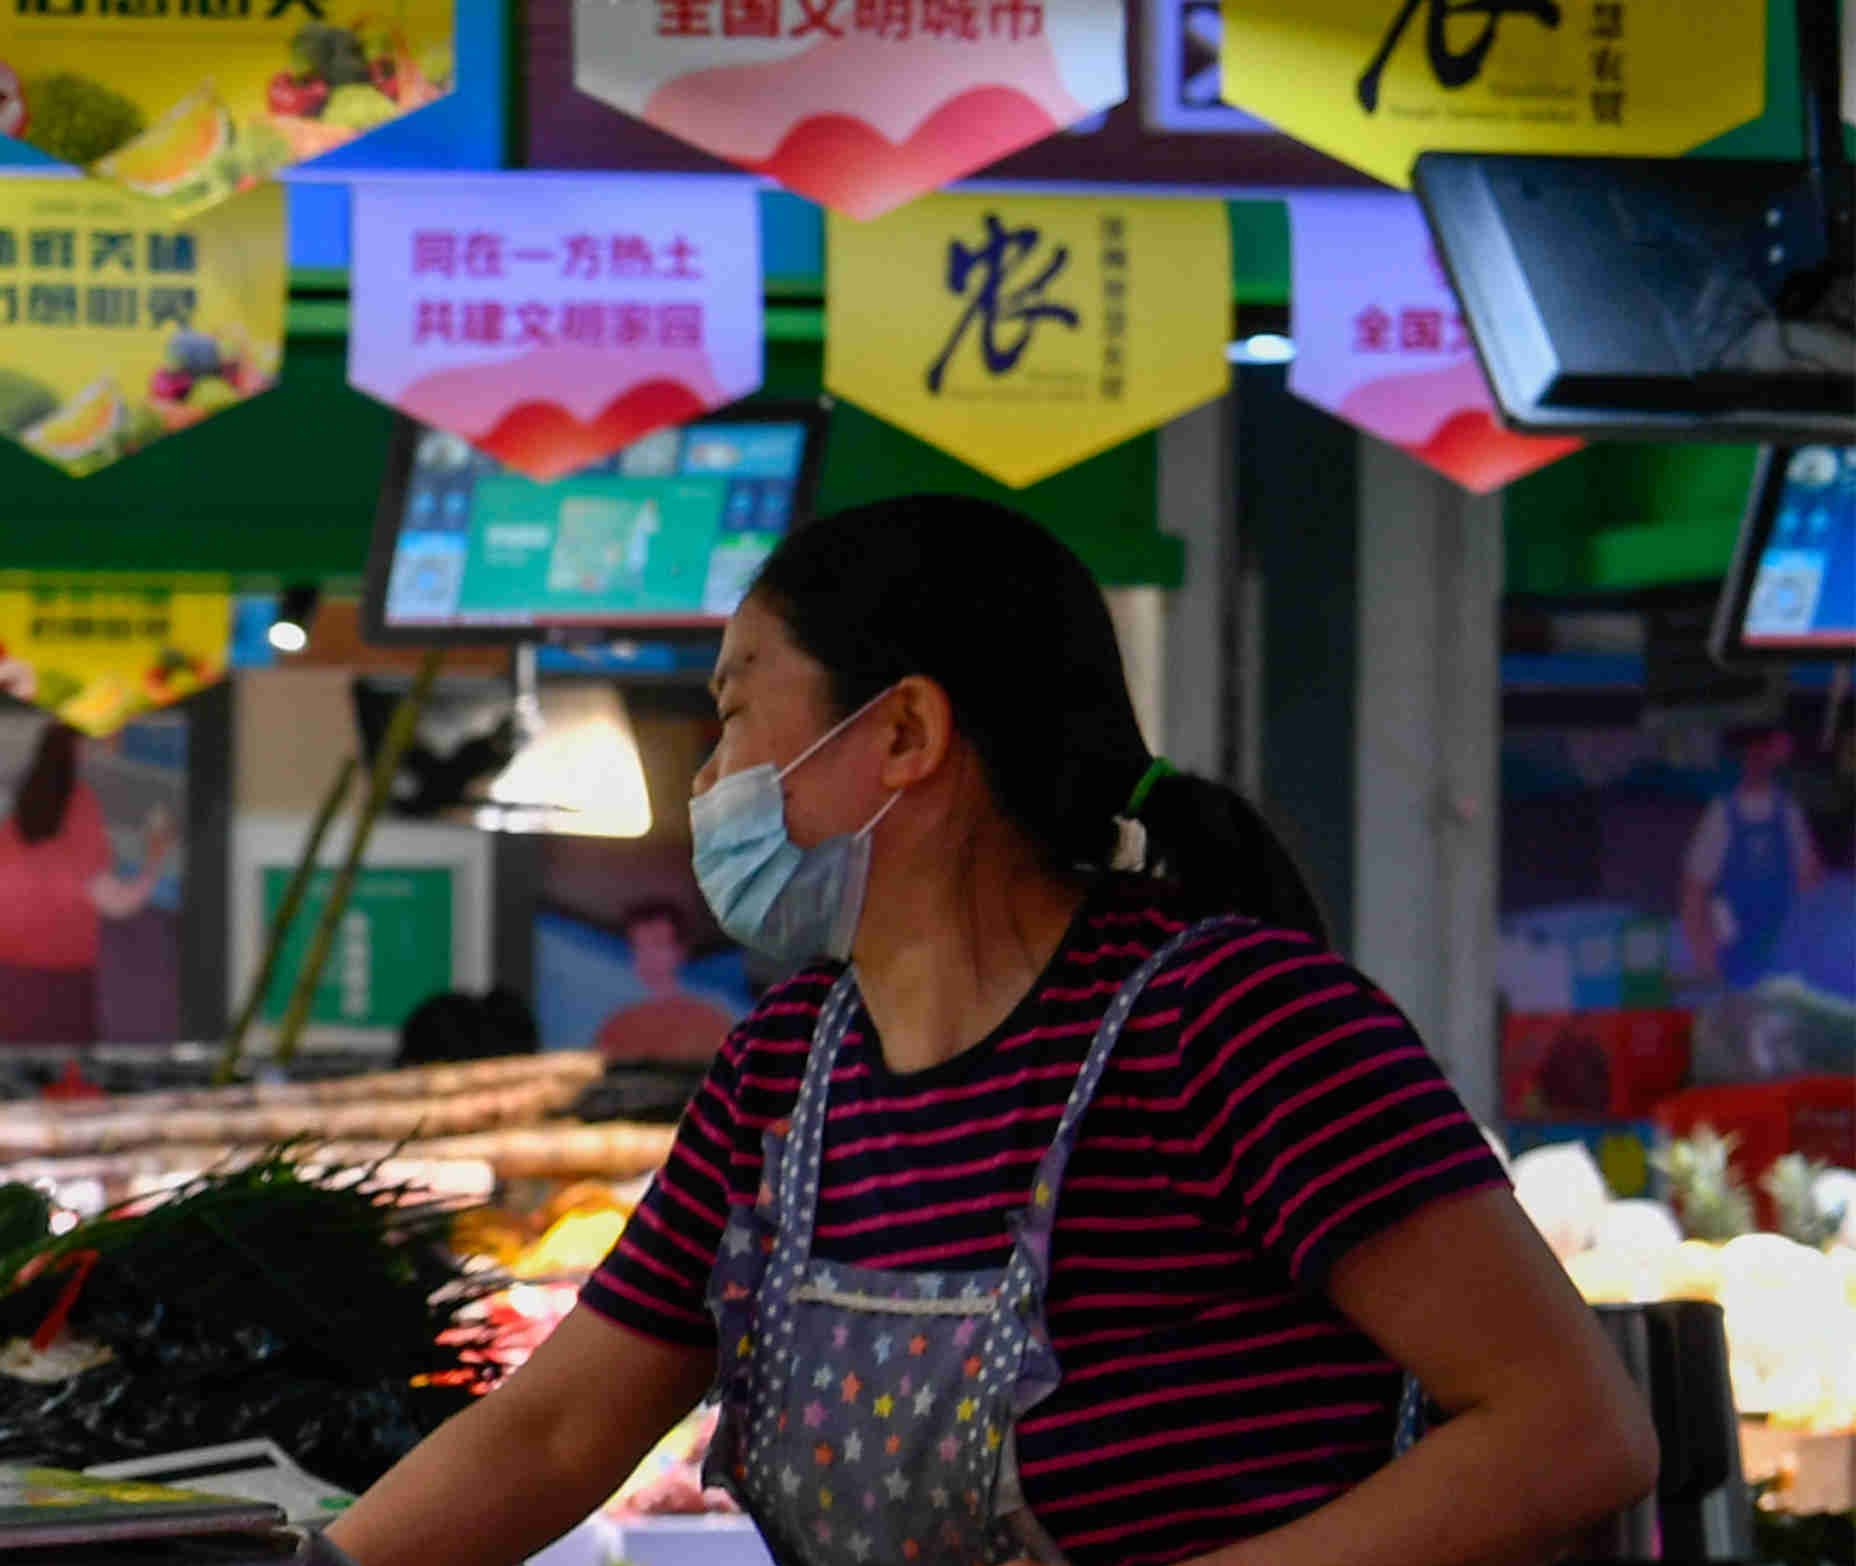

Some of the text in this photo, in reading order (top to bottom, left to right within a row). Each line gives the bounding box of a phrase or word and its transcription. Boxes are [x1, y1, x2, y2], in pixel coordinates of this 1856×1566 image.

[412, 228, 703, 281] 同在一方热土
[412, 299, 706, 350] 共建文明家园
